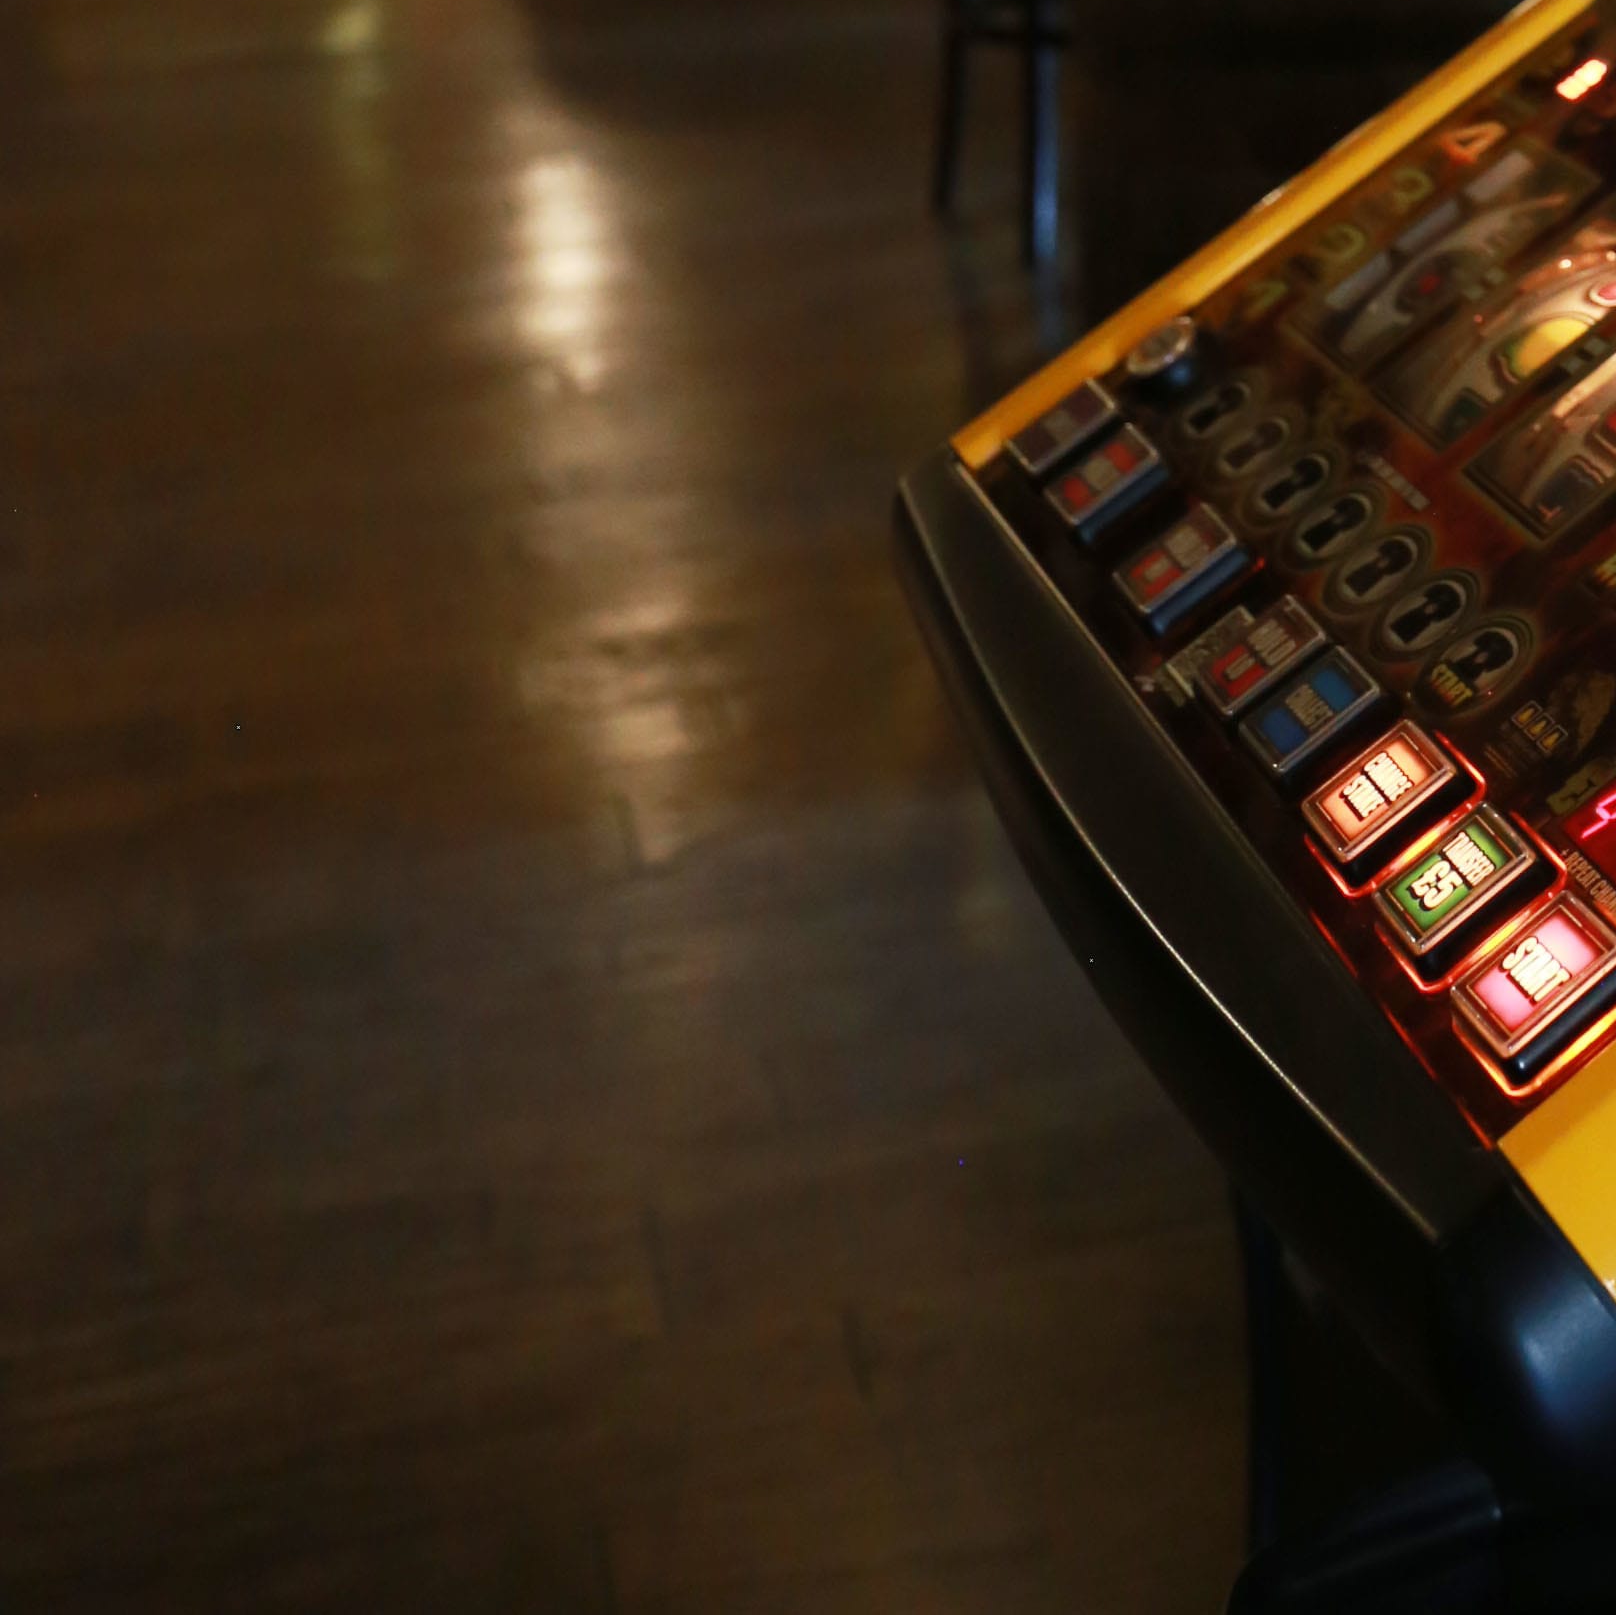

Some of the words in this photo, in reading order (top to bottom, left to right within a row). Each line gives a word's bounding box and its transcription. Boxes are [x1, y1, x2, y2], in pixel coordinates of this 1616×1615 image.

[1430, 661, 1474, 707] START
[1341, 773, 1385, 820] STAKE
[1363, 750, 1416, 803] CHANGE
[1408, 858, 1465, 911] £5
[1440, 830, 1497, 889] TRANSFER
[1563, 850, 1602, 897] REPEAT
[1501, 934, 1573, 1004] START
